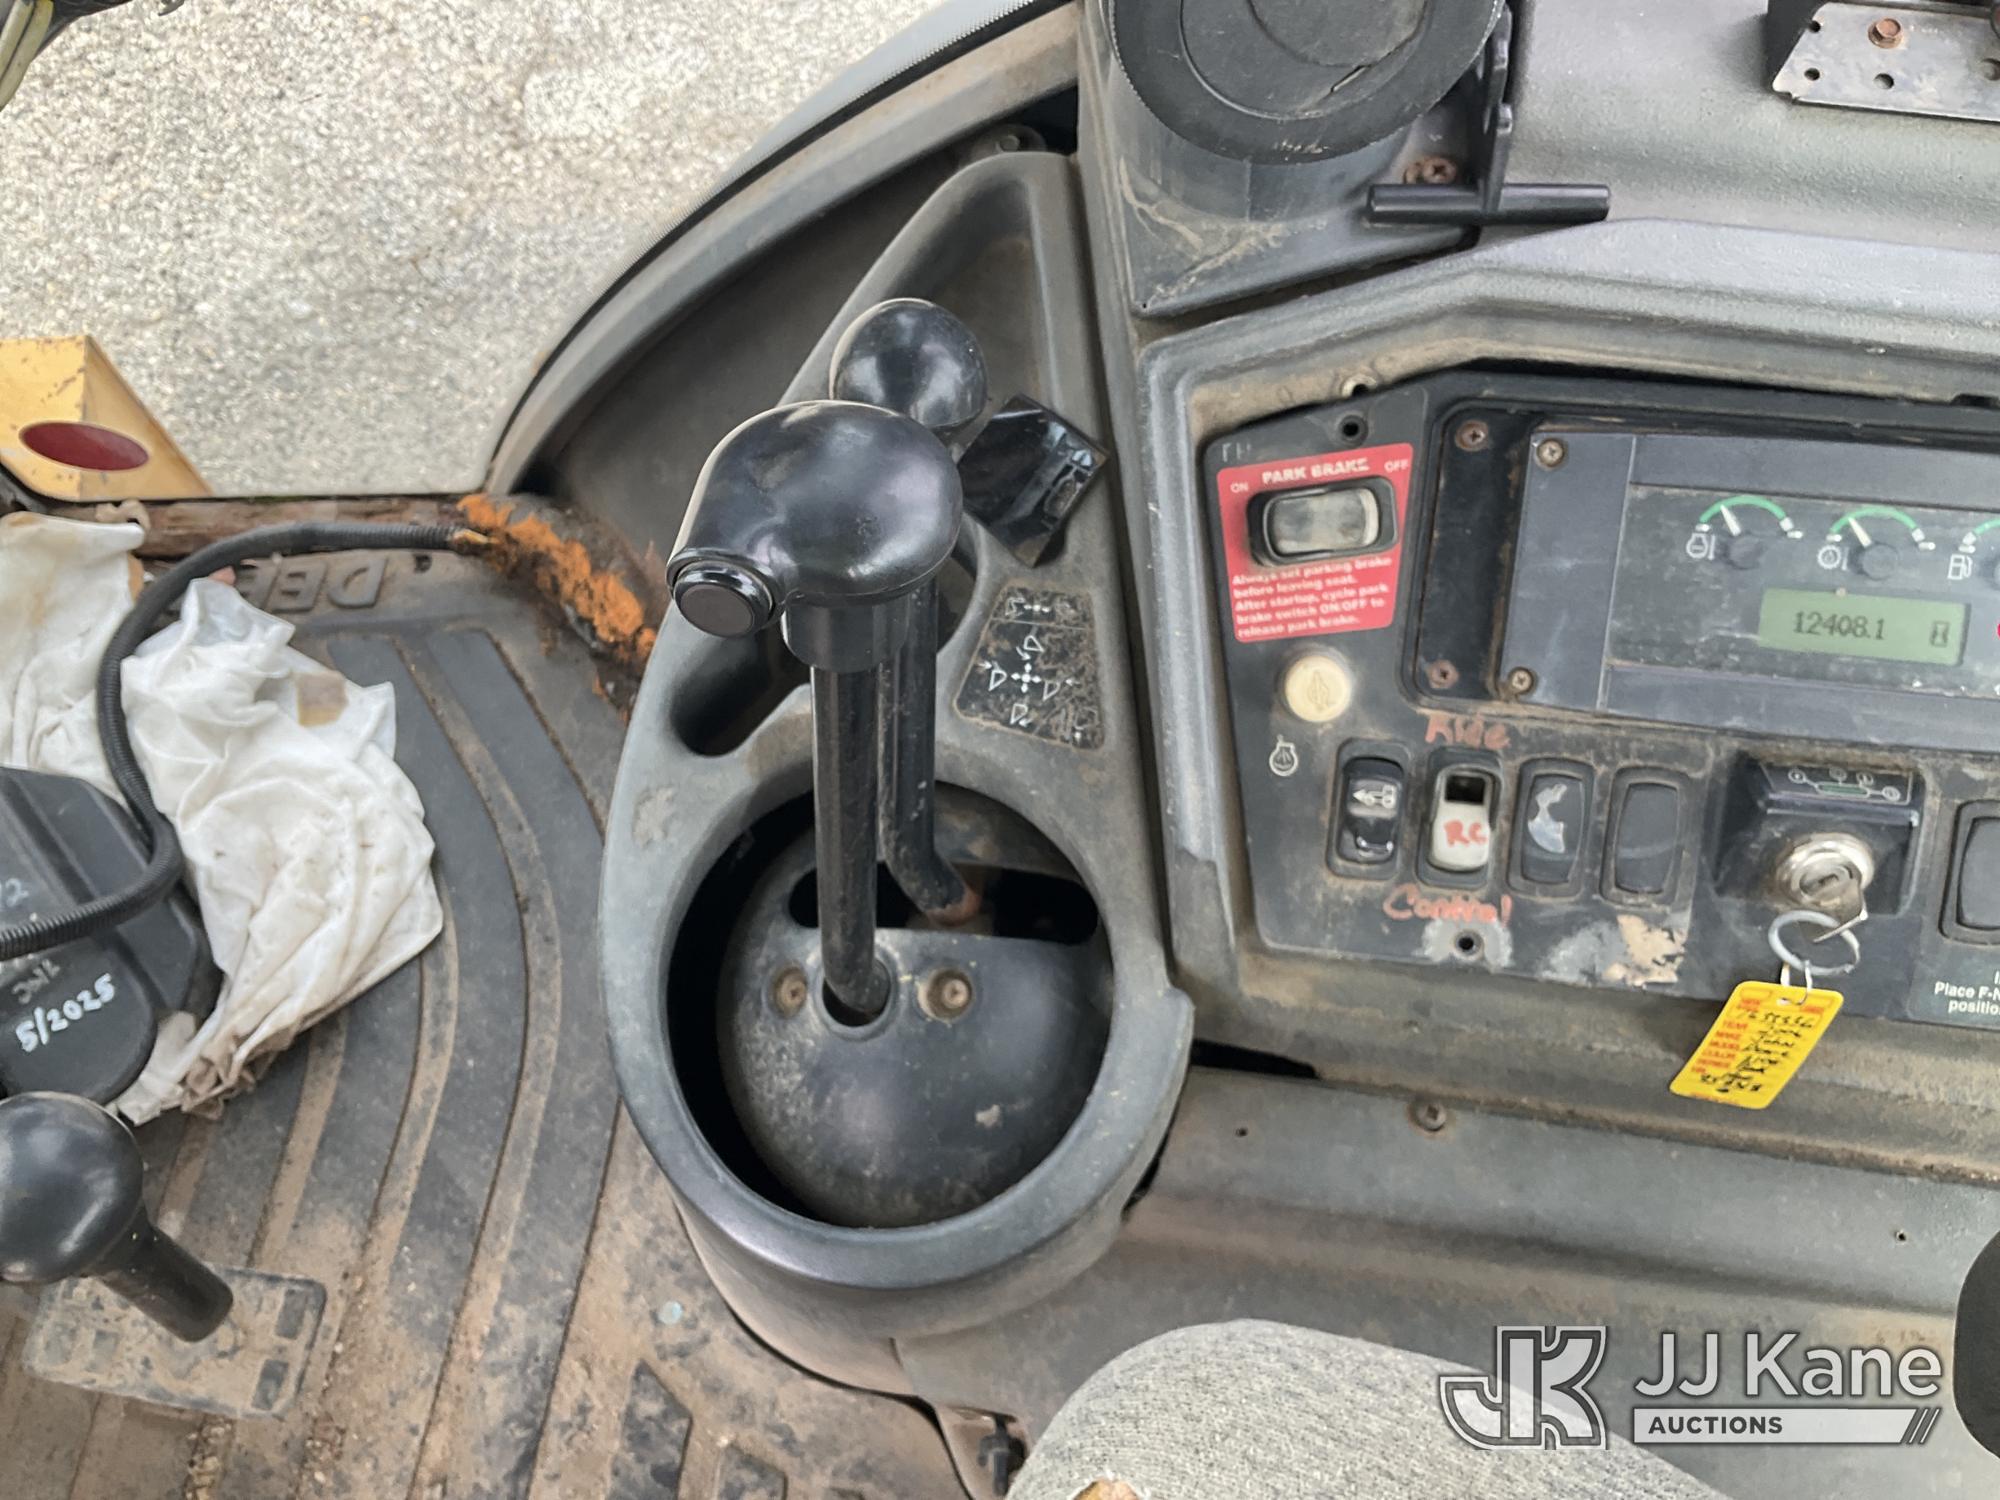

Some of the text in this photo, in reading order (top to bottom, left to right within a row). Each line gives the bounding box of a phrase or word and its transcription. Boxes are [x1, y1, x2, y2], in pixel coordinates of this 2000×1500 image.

[1262, 458, 1370, 484] PARK BRAKE
[1384, 459, 1409, 472] OFF
[1230, 482, 1249, 493] ON
[1232, 557, 1392, 585] Always set parking brake
[1233, 585, 1274, 599] before
[1276, 580, 1323, 593] leaving
[1235, 598, 1267, 612] After
[1359, 583, 1390, 597] park
[1236, 612, 1272, 625] brake
[1275, 606, 1317, 619] switch
[1371, 598, 1385, 608] to
[1238, 624, 1285, 637] release
[1287, 619, 1317, 632] park
[1793, 611, 1885, 640] 12408.1
[1443, 820, 1487, 846] RC
[1934, 980, 1976, 998] Place
[16, 973, 115, 1052] 5/2025
[1948, 1000, 2000, 1016] positio
